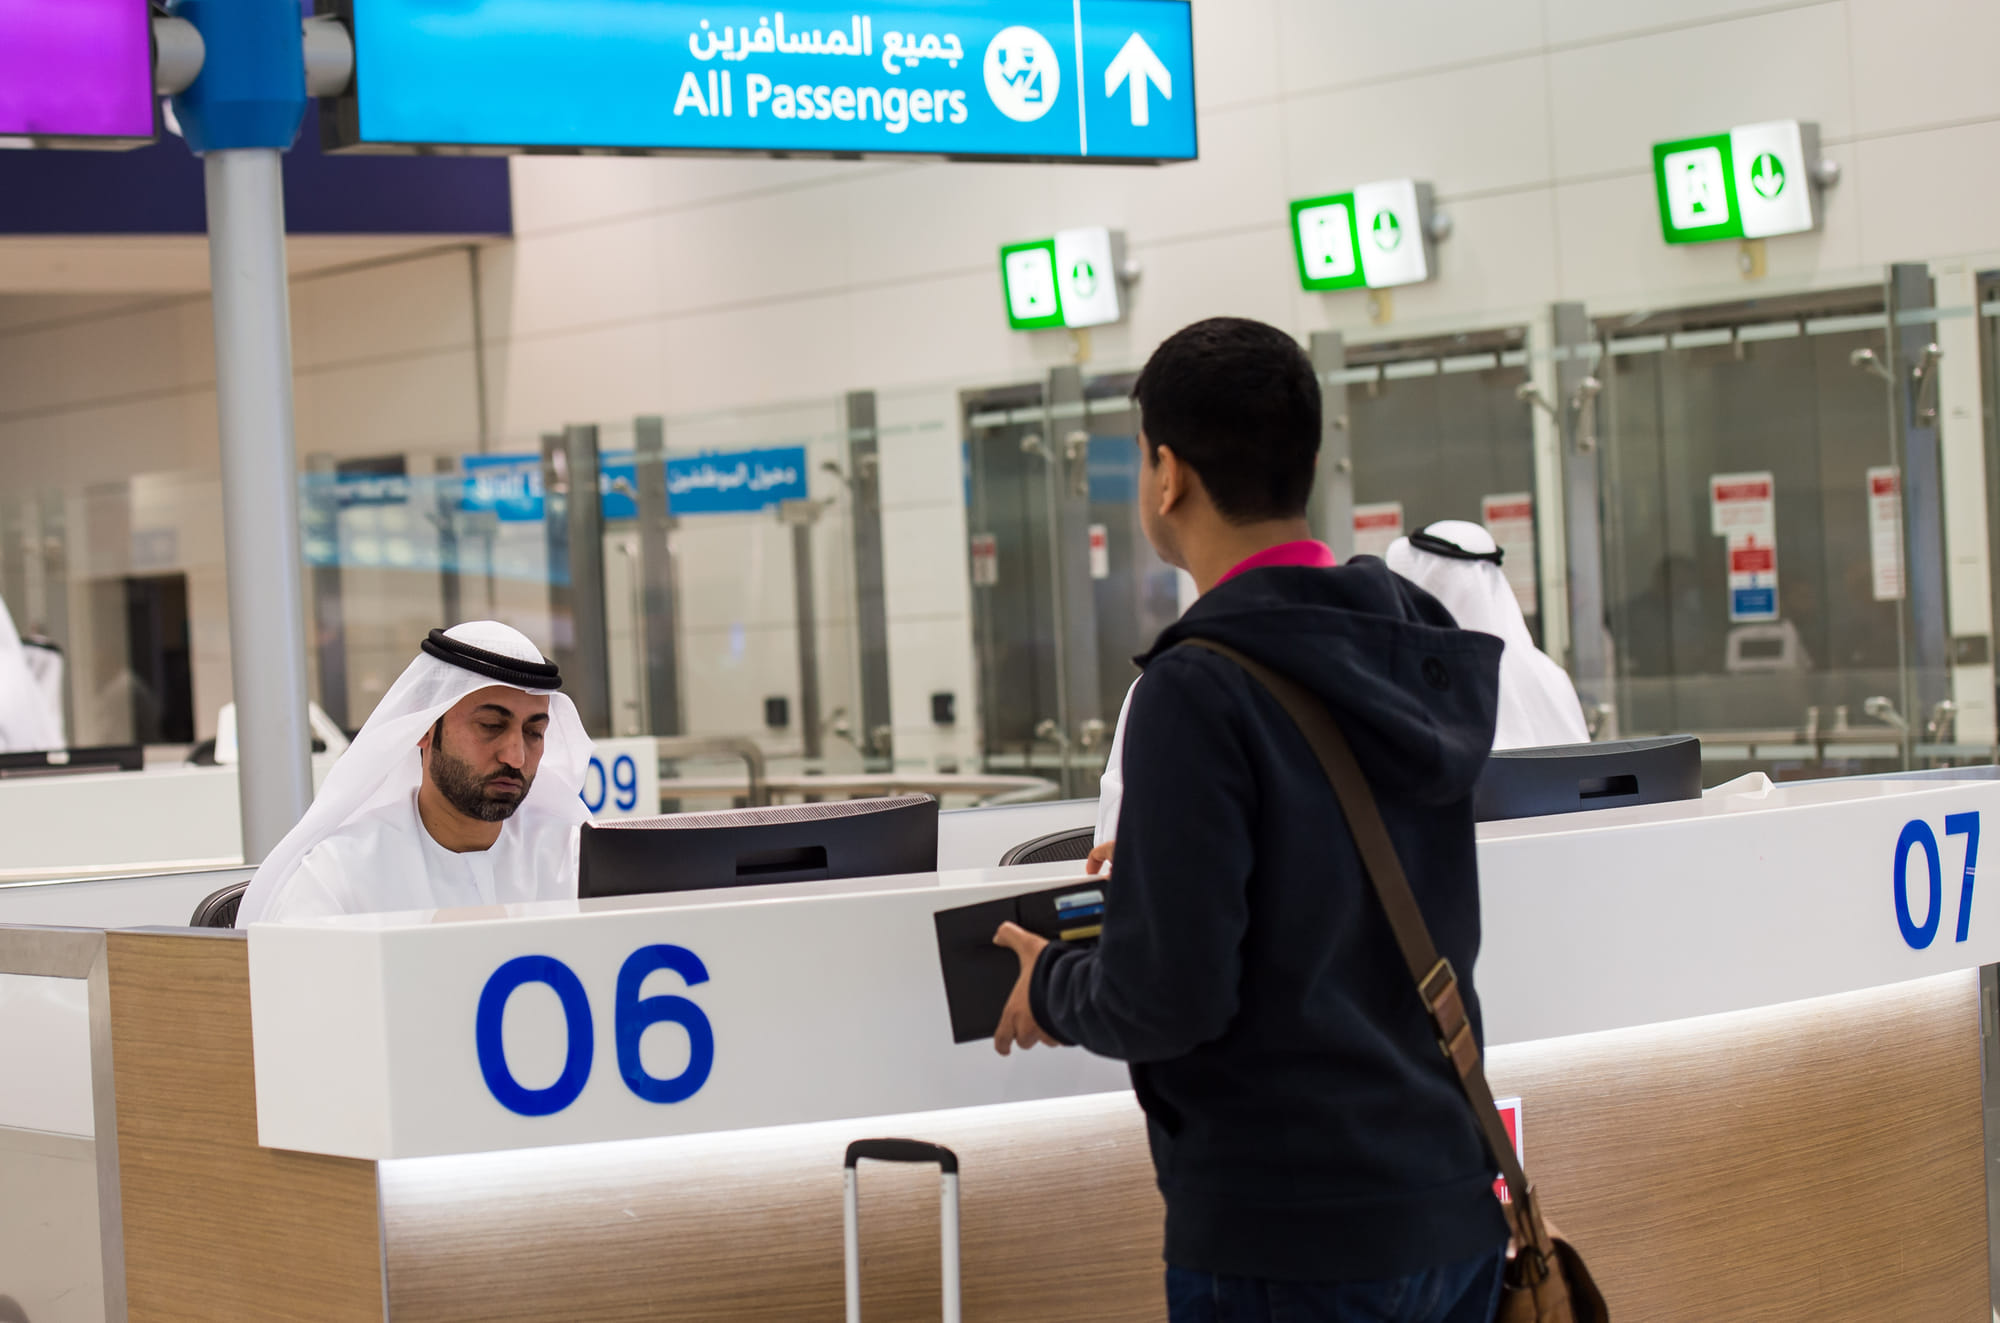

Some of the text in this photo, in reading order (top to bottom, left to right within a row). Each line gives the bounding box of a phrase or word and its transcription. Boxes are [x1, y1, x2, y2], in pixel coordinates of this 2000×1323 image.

[689, 12, 964, 75] جميع المسافرين
[673, 69, 968, 134] All Passengers
[578, 754, 637, 814] 09
[1893, 811, 1980, 950] 07
[475, 943, 715, 1117] 06
